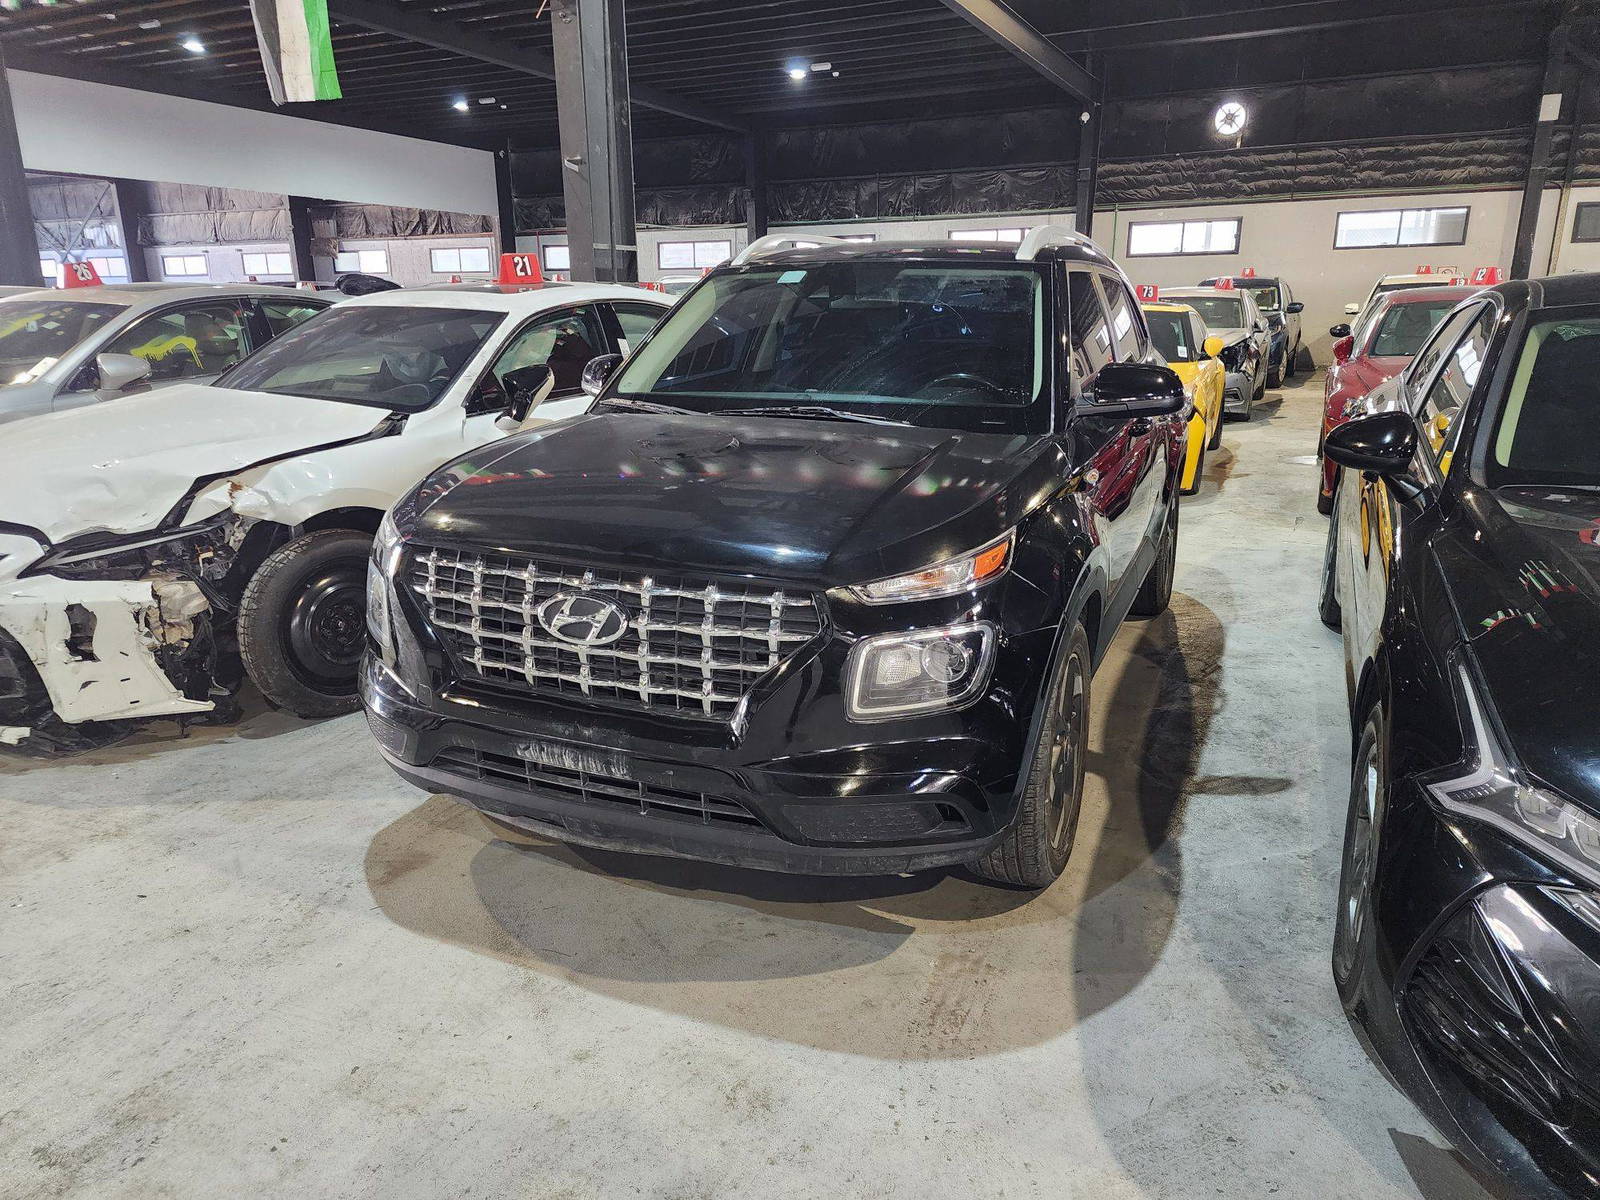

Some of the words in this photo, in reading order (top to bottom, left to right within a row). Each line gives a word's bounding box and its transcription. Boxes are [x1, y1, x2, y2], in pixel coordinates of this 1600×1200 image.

[72, 262, 93, 280] 26
[513, 255, 532, 276] 21
[1476, 267, 1487, 281] 12
[1143, 286, 1154, 298] 73
